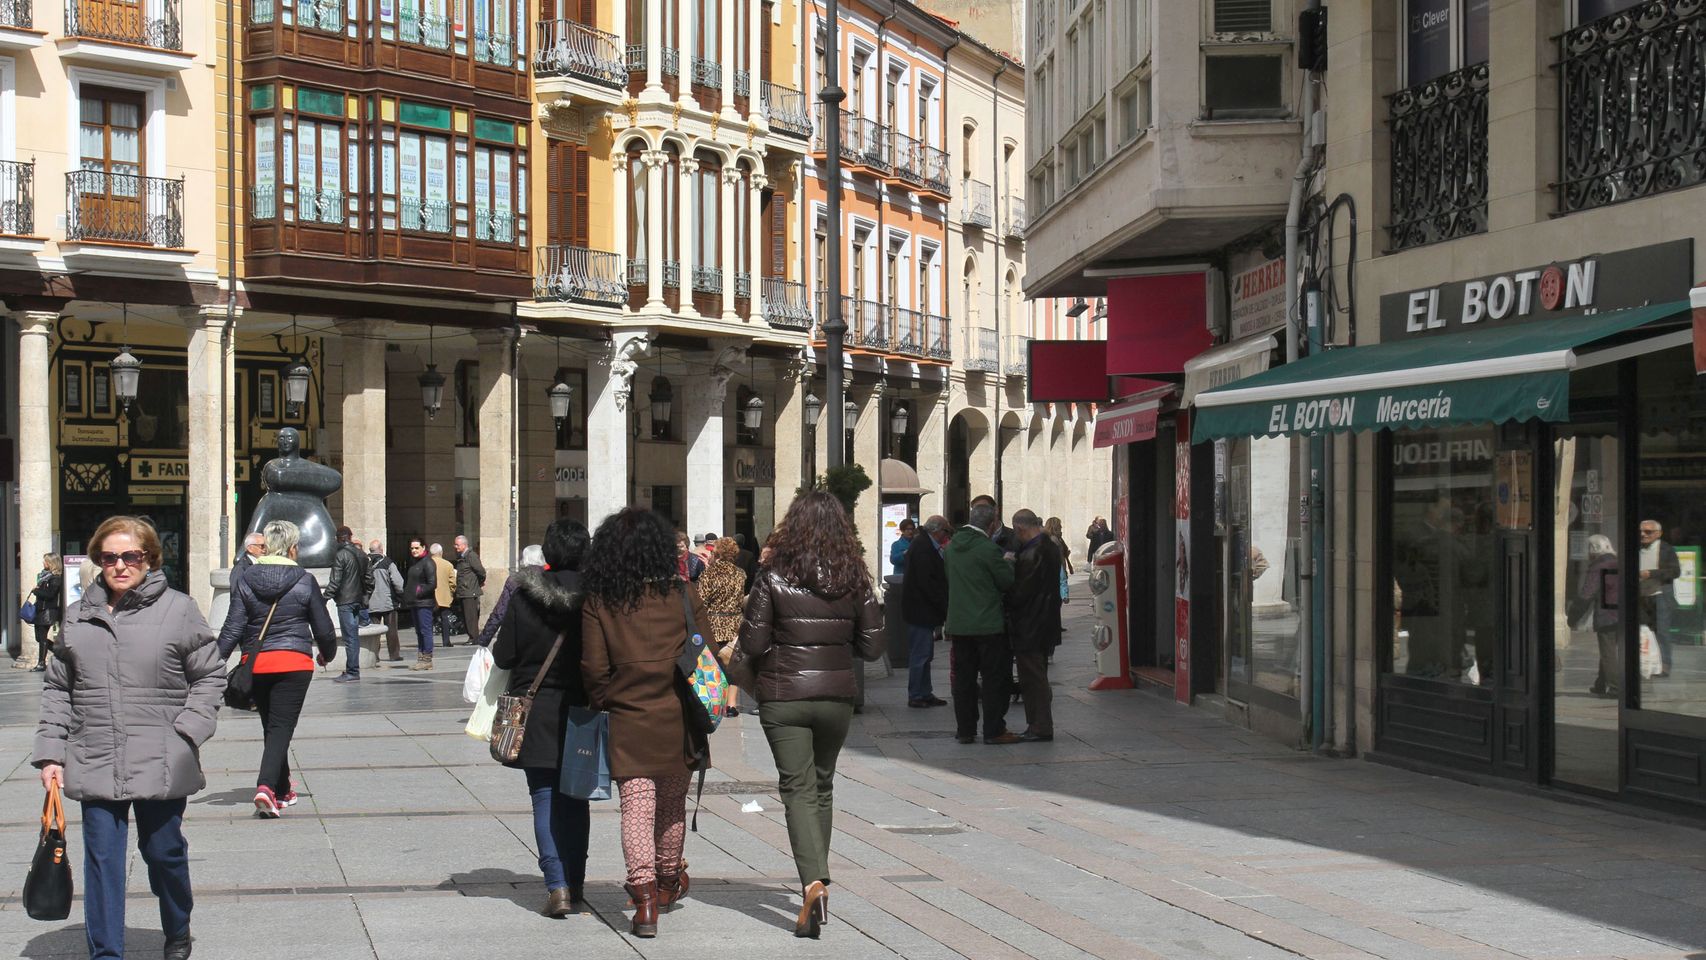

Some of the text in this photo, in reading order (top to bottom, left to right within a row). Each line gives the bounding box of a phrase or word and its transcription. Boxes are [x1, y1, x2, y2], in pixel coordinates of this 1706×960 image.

[1423, 9, 1449, 28] Clever
[1406, 288, 1447, 333] EL
[1461, 260, 1596, 324] BOTON
[1269, 391, 1452, 432] EL BOTON Mercería
